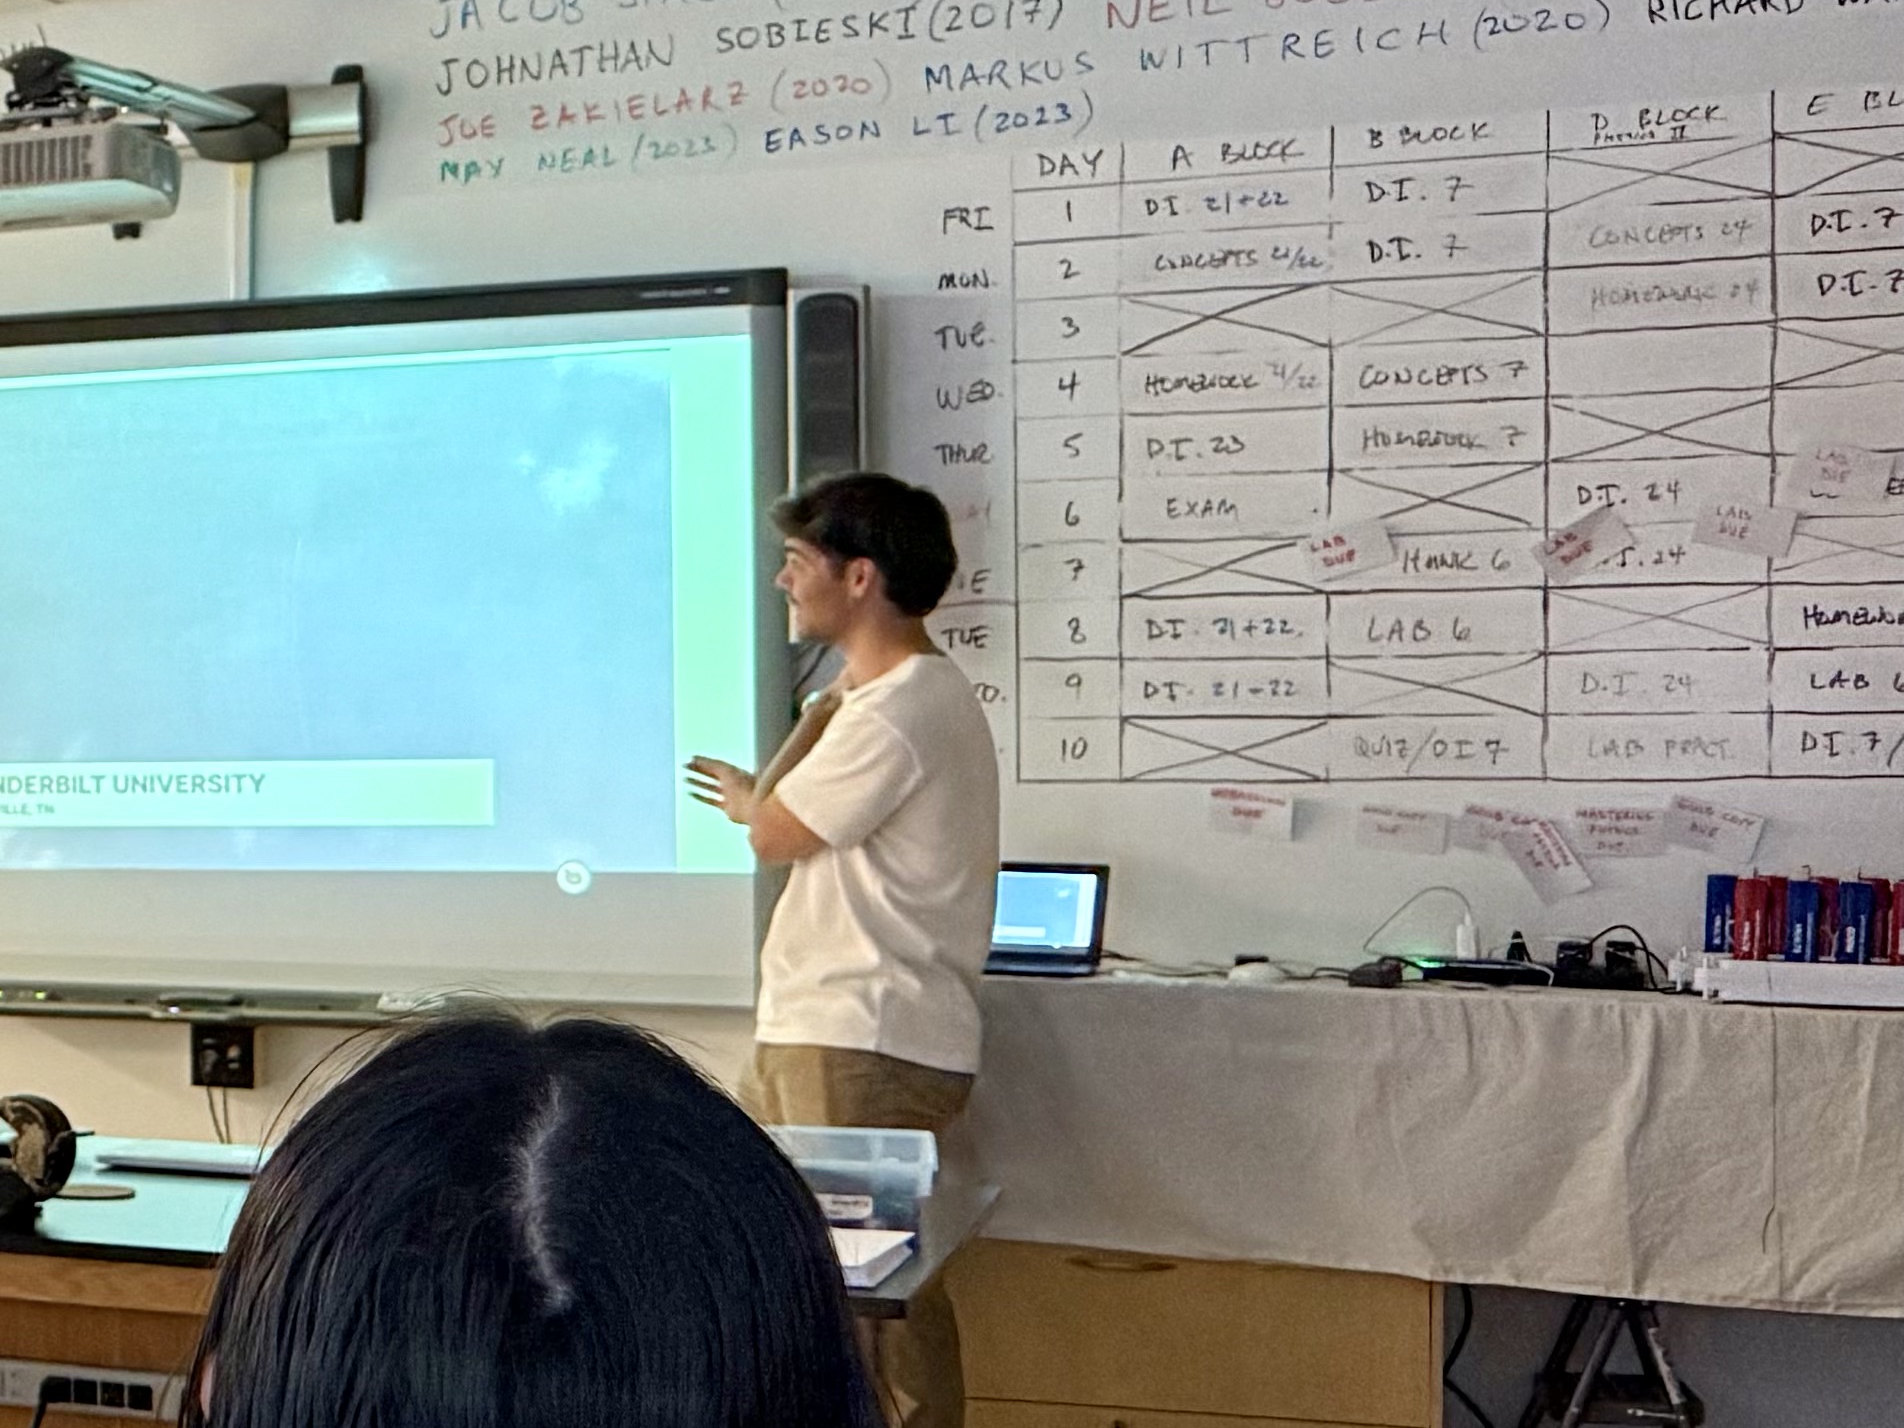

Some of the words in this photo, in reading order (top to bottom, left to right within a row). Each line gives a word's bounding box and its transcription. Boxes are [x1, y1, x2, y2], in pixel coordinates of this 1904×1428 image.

[437, 34, 674, 96] JOHNATHAN
[717, 7, 917, 53] SOBIESKI
[439, 113, 496, 148] JOE
[925, 51, 1095, 93] MARKUS
[1140, 19, 1448, 71] WITTREICH
[537, 145, 617, 172] NEAL
[765, 122, 881, 153] EASON
[913, 113, 964, 137] LI
[975, 89, 1093, 143] (2023)
[1038, 149, 1104, 177] DAY
[1172, 146, 1192, 169] A
[1221, 138, 1303, 164] BLOCK
[1400, 122, 1492, 146] BLOCK
[1639, 105, 1726, 130] BLOCK
[1808, 94, 1833, 115] E
[943, 209, 993, 235] FRI
[1060, 260, 1080, 279] 2
[1062, 318, 1080, 338] 3
[1059, 371, 1078, 396] 4
[1359, 364, 1488, 389] CONCEPTS
[1063, 433, 1084, 458] 5
[1065, 501, 1081, 526] 6
[1167, 498, 1239, 521] EXAM
[1068, 618, 1087, 645] 8
[1368, 615, 1432, 642] LAB
[1065, 676, 1081, 700] 9
[1810, 670, 1869, 691] LAB
[1061, 736, 1088, 762] 10
[113, 774, 265, 794] UNIVERSITY
